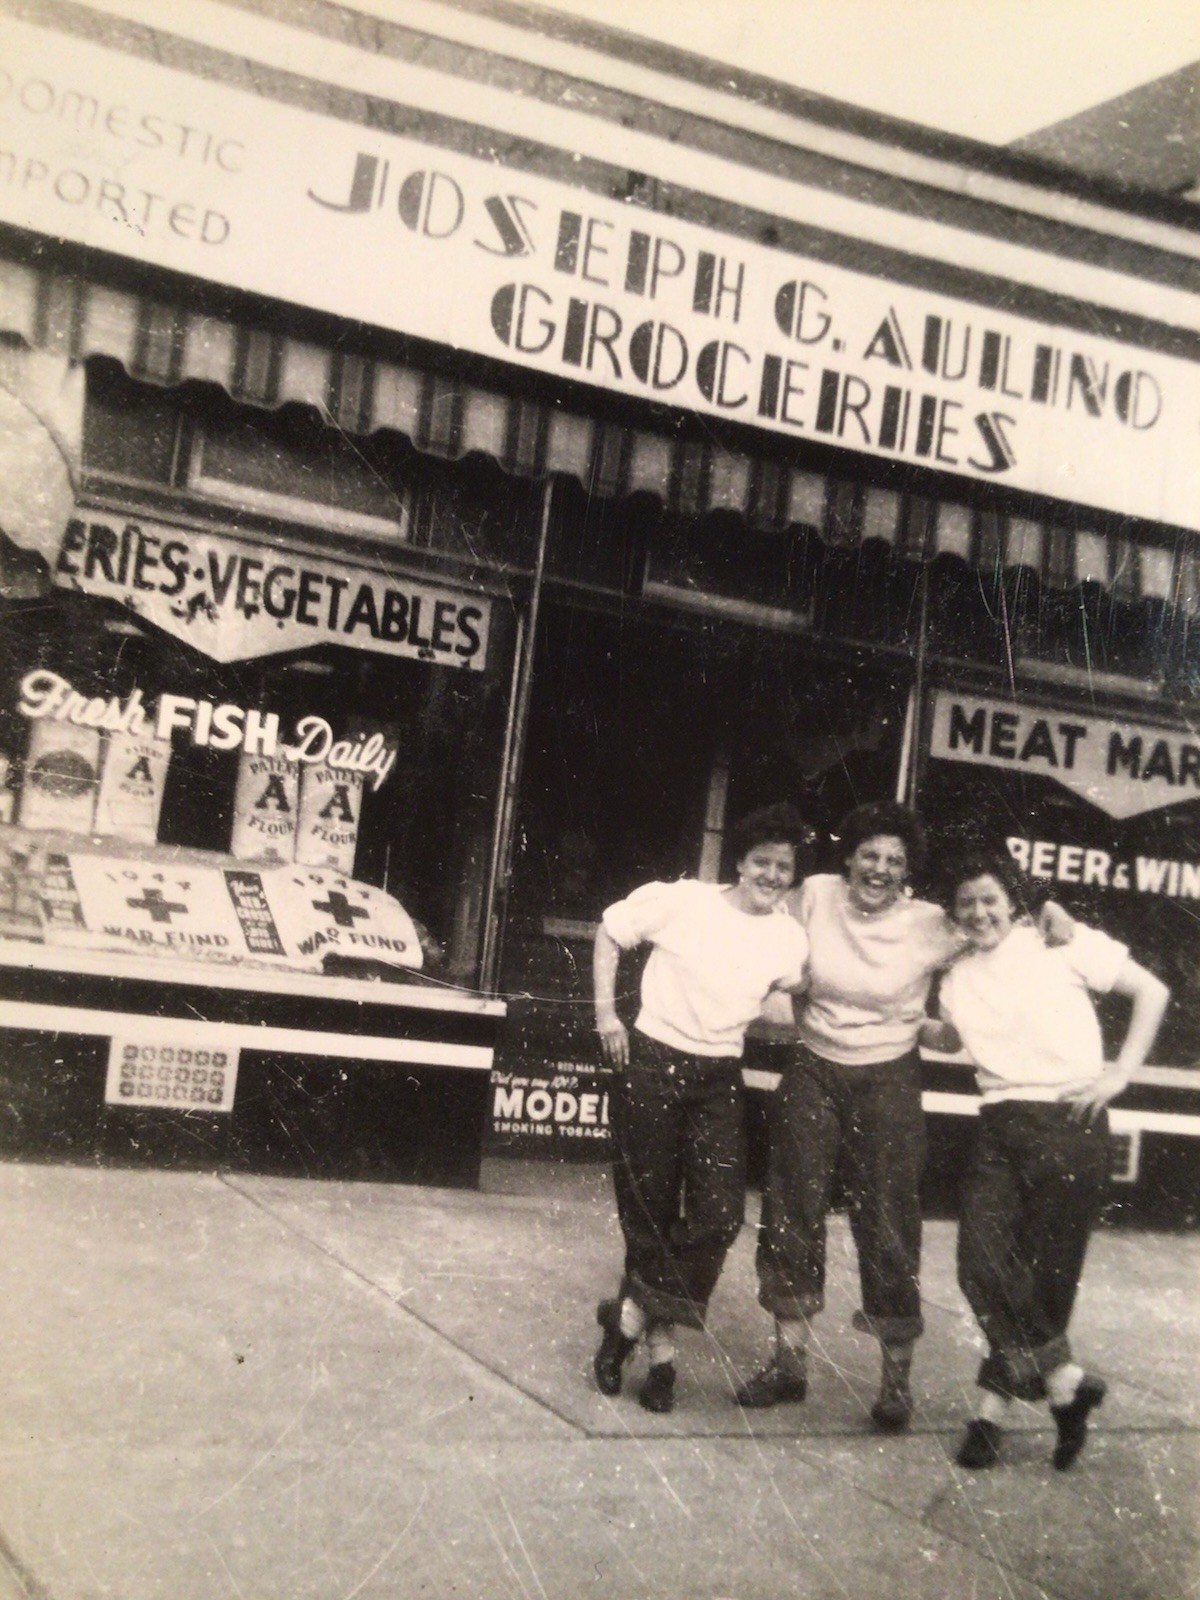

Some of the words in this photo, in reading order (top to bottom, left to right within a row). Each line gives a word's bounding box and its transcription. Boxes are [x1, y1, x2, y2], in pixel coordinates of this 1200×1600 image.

[307, 151, 746, 325] JOSEPH
[774, 280, 846, 353] G.
[863, 305, 1163, 430] AULINO
[490, 282, 1018, 474] GROCERIES
[18, 669, 149, 734] Fresh
[156, 694, 280, 756] FISH
[284, 716, 397, 793] Daily
[948, 704, 1088, 770] MEAT
[1107, 730, 1200, 787] MAR
[126, 756, 153, 782] A
[254, 774, 291, 813] A
[318, 785, 355, 824] A
[103, 926, 153, 946] WAR
[165, 931, 230, 946] FUND
[348, 932, 407, 953] FUND
[493, 1121, 553, 1136] SMOKING
